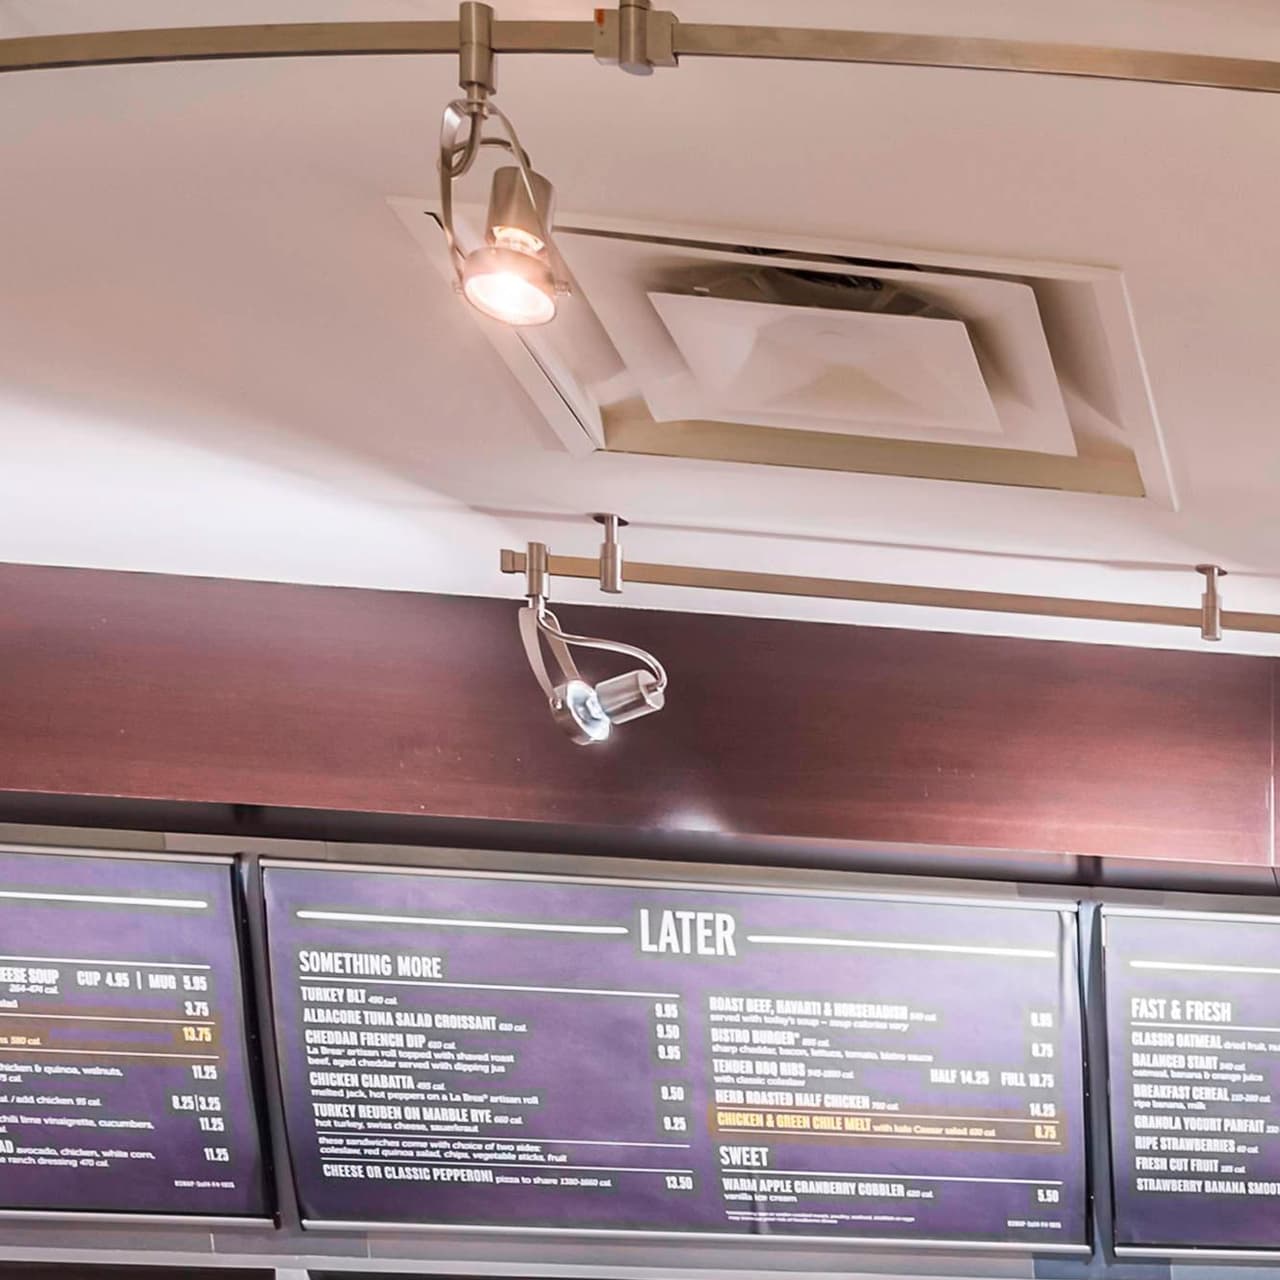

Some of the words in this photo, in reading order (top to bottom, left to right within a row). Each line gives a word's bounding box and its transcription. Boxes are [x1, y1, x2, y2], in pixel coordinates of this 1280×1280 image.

[639, 908, 737, 956] LATER
[299, 950, 392, 977] SOMETHING
[397, 955, 443, 979] MORE
[29, 968, 60, 985] SOUP
[77, 971, 100, 987] CUP
[149, 974, 177, 990] MUG
[300, 986, 344, 1002] TURKEY
[346, 989, 366, 1003] BLT
[184, 1001, 209, 1017] 3.75
[1131, 998, 1166, 1020] FAST
[1170, 1001, 1181, 1021] &
[1186, 1001, 1232, 1023] FRESH
[304, 1008, 362, 1024] ALBACORE
[363, 1011, 394, 1026] TUNA
[395, 1012, 432, 1028] SALAD
[434, 1014, 497, 1030] CROISSANT
[182, 1026, 212, 1042] 13.75
[305, 1029, 358, 1045] CHEDDAR
[360, 1031, 404, 1047] FRENCH
[405, 1033, 427, 1049] DIP
[192, 1065, 217, 1080] 11.25
[310, 1072, 359, 1087] CHICKEN
[361, 1073, 415, 1089] CIABATTA
[1133, 1084, 1191, 1100] BREAKFAST
[312, 1103, 355, 1118] TURKEY
[358, 1104, 402, 1119] REUBEN
[403, 1106, 421, 1120] ON
[422, 1107, 469, 1122] MARBLE
[470, 1109, 492, 1123] RYE
[199, 1116, 225, 1132] 11.25
[717, 1112, 765, 1127] CHICKEN
[776, 1114, 811, 1129] GREEN
[812, 1115, 843, 1130] CHILE
[844, 1118, 872, 1132] MELT
[1223, 1119, 1265, 1134] PARFAIT
[484, 1142, 495, 1150] of
[496, 1143, 514, 1151] two
[1160, 1136, 1236, 1153] STRAWBERRIES
[204, 1147, 229, 1162] 11.25
[719, 1145, 768, 1167] SWEET
[323, 1164, 365, 1178] CHEESE
[366, 1165, 382, 1179] OR
[384, 1166, 431, 1180] CLASSIC
[432, 1167, 493, 1182] PEPPERONI
[1136, 1157, 1169, 1172] FRESH
[1170, 1158, 1190, 1172] CUT
[1190, 1159, 1219, 1174] FRUIT
[666, 1176, 693, 1190] 13.50
[722, 1178, 758, 1193] WARM
[759, 1179, 793, 1193] APPLE
[794, 1181, 856, 1196] CRANBERRY
[857, 1182, 905, 1198] COBBLER
[1137, 1178, 1203, 1194] STRAWBERRY
